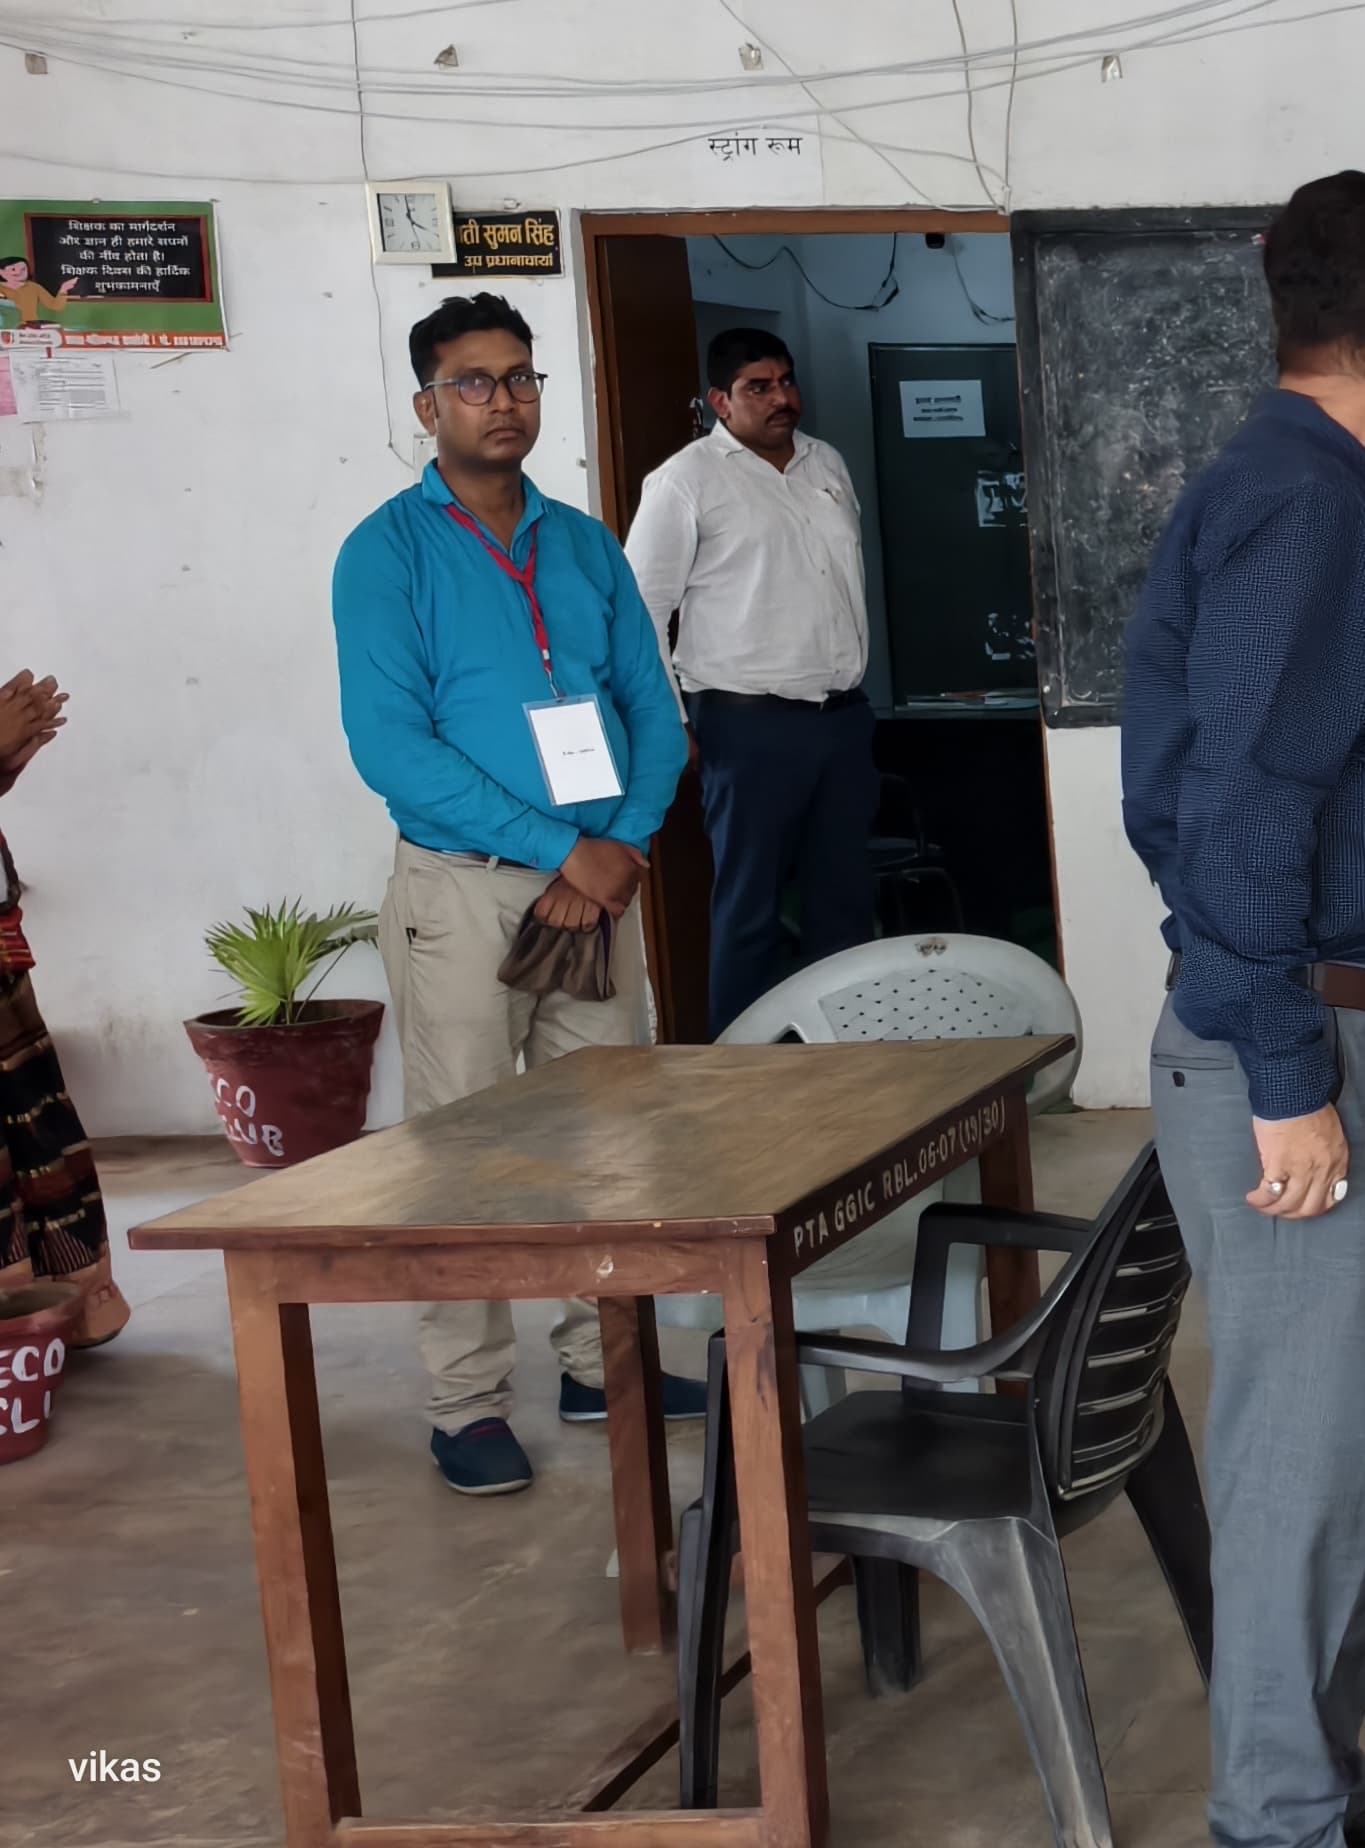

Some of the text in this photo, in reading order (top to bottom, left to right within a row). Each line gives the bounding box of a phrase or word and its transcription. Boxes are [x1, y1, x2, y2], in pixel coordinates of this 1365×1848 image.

[765, 137, 803, 156] रूम
[68, 219, 106, 232] शिक्षक
[482, 224, 522, 249] सुमन
[525, 217, 555, 246] सिंह
[793, 1211, 829, 1257] PTA
[834, 1180, 876, 1232] GGIC
